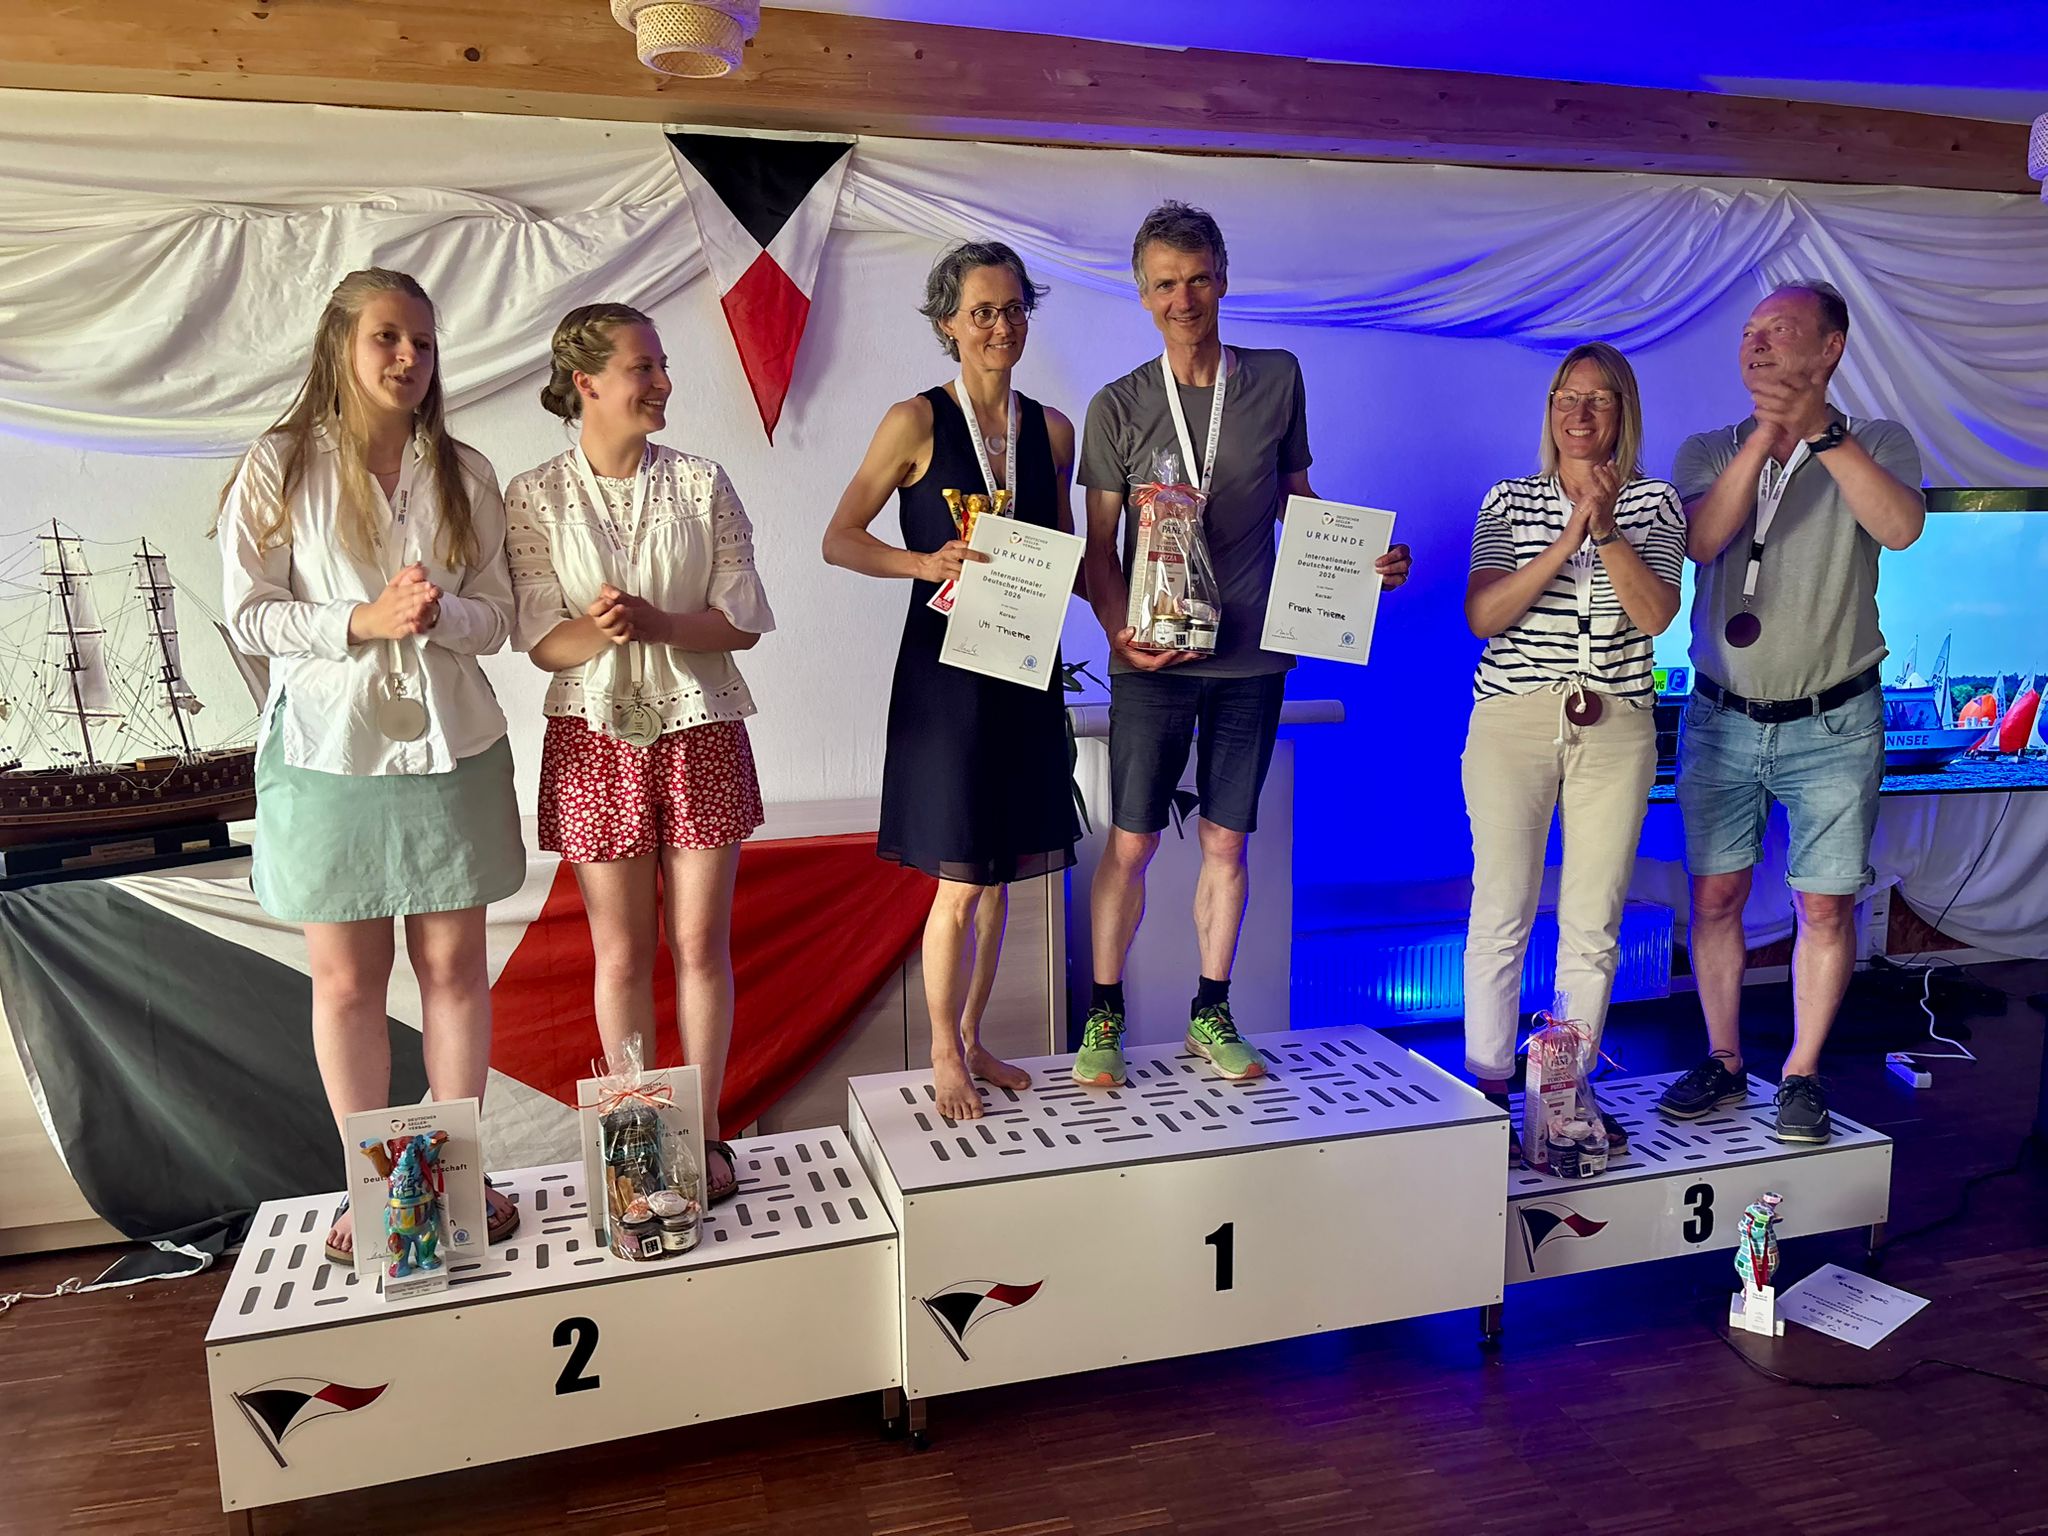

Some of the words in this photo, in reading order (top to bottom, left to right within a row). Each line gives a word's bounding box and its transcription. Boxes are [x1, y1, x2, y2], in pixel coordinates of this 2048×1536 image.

[1306, 530, 1365, 547] URKUNDE
[993, 547, 1052, 570] URKUNDE
[1305, 552, 1357, 567] Internationaler
[1297, 559, 1332, 571] Deutscher
[1334, 565, 1361, 576] Meister
[1319, 570, 1337, 580] 2026
[982, 575, 1018, 591] Deutscher
[1019, 586, 1047, 599] Meister
[991, 569, 1043, 589] Internationaler
[1003, 589, 1022, 600] 2026
[1288, 601, 1313, 614] Frank
[995, 624, 1032, 641] Thieme
[1654, 680, 1665, 690] VG
[1886, 735, 1930, 747] NNSEE
[1683, 1184, 1714, 1243] 3
[1204, 1222, 1234, 1292] 1
[553, 1317, 601, 1396] 2
